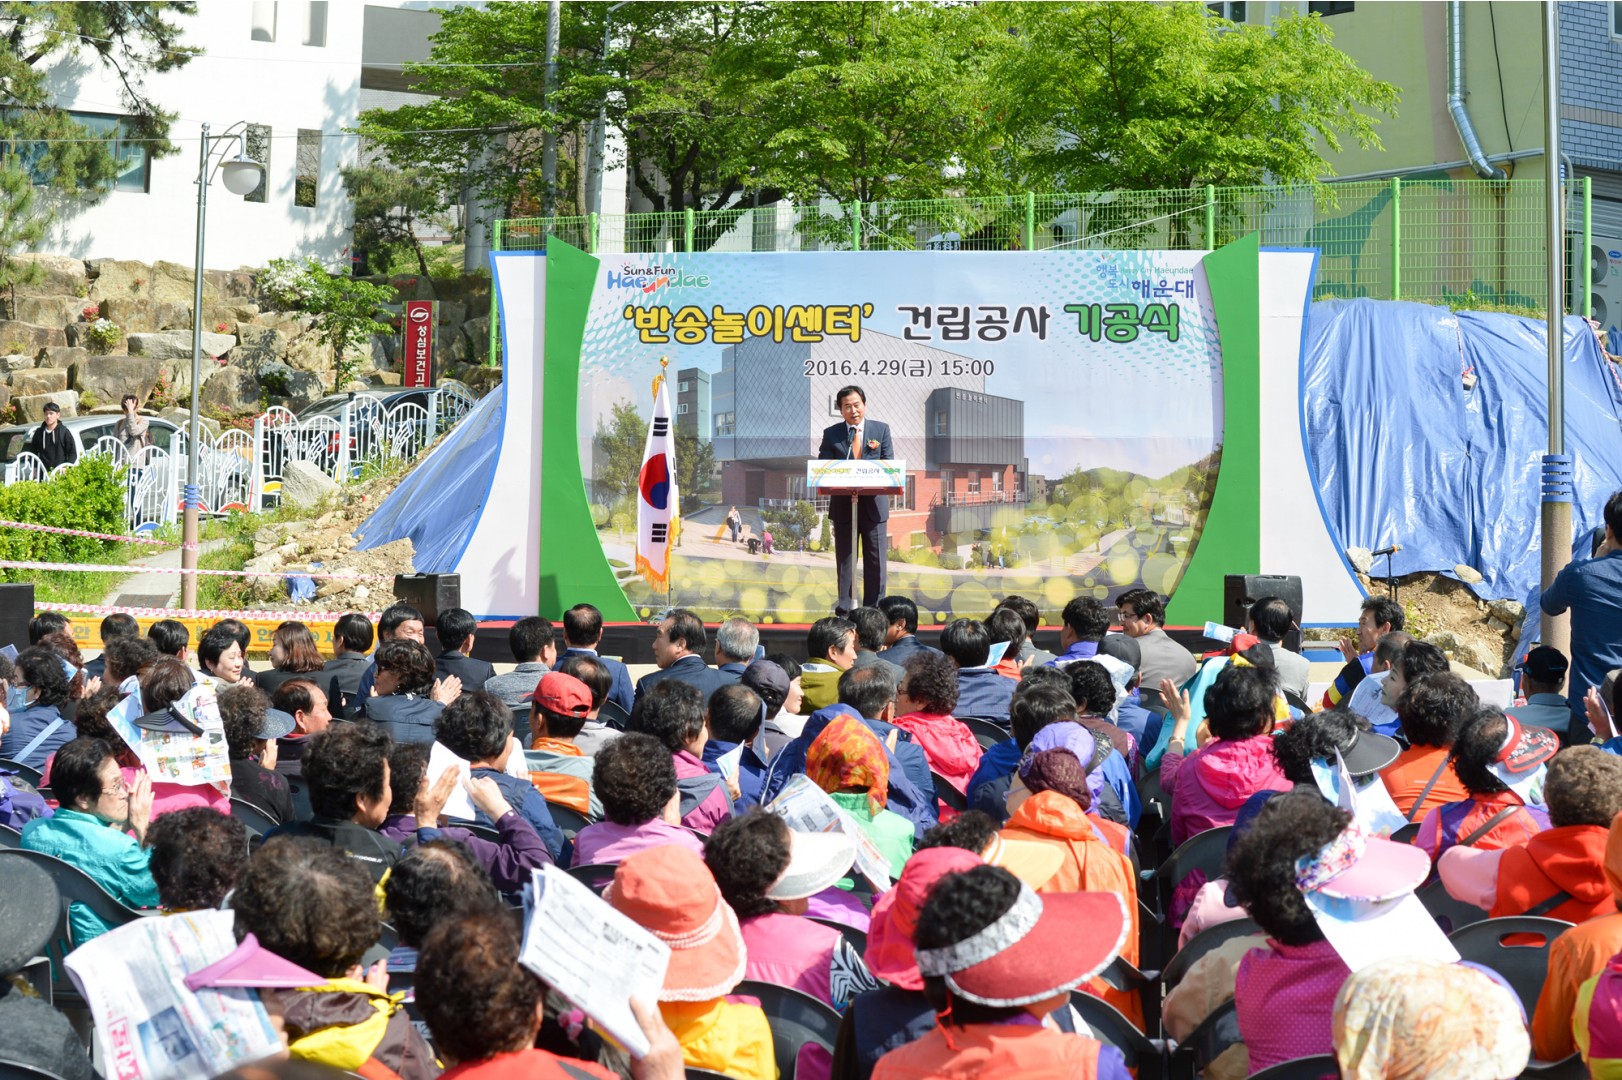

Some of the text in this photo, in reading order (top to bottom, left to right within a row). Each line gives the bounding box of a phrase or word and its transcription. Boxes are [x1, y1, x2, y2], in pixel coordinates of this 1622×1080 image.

[623, 265, 676, 276] Sun&Fun
[1096, 264, 1119, 279] 행복
[1154, 266, 1194, 274] Haeundae
[607, 269, 711, 294] Haeundae
[1107, 278, 1195, 299] 도시 해운대
[897, 304, 1051, 342] 건립공사
[1063, 302, 1181, 343] 기공식
[415, 326, 427, 388] 성심보건고
[803, 359, 994, 378] 2016.4.29(금) 15:00
